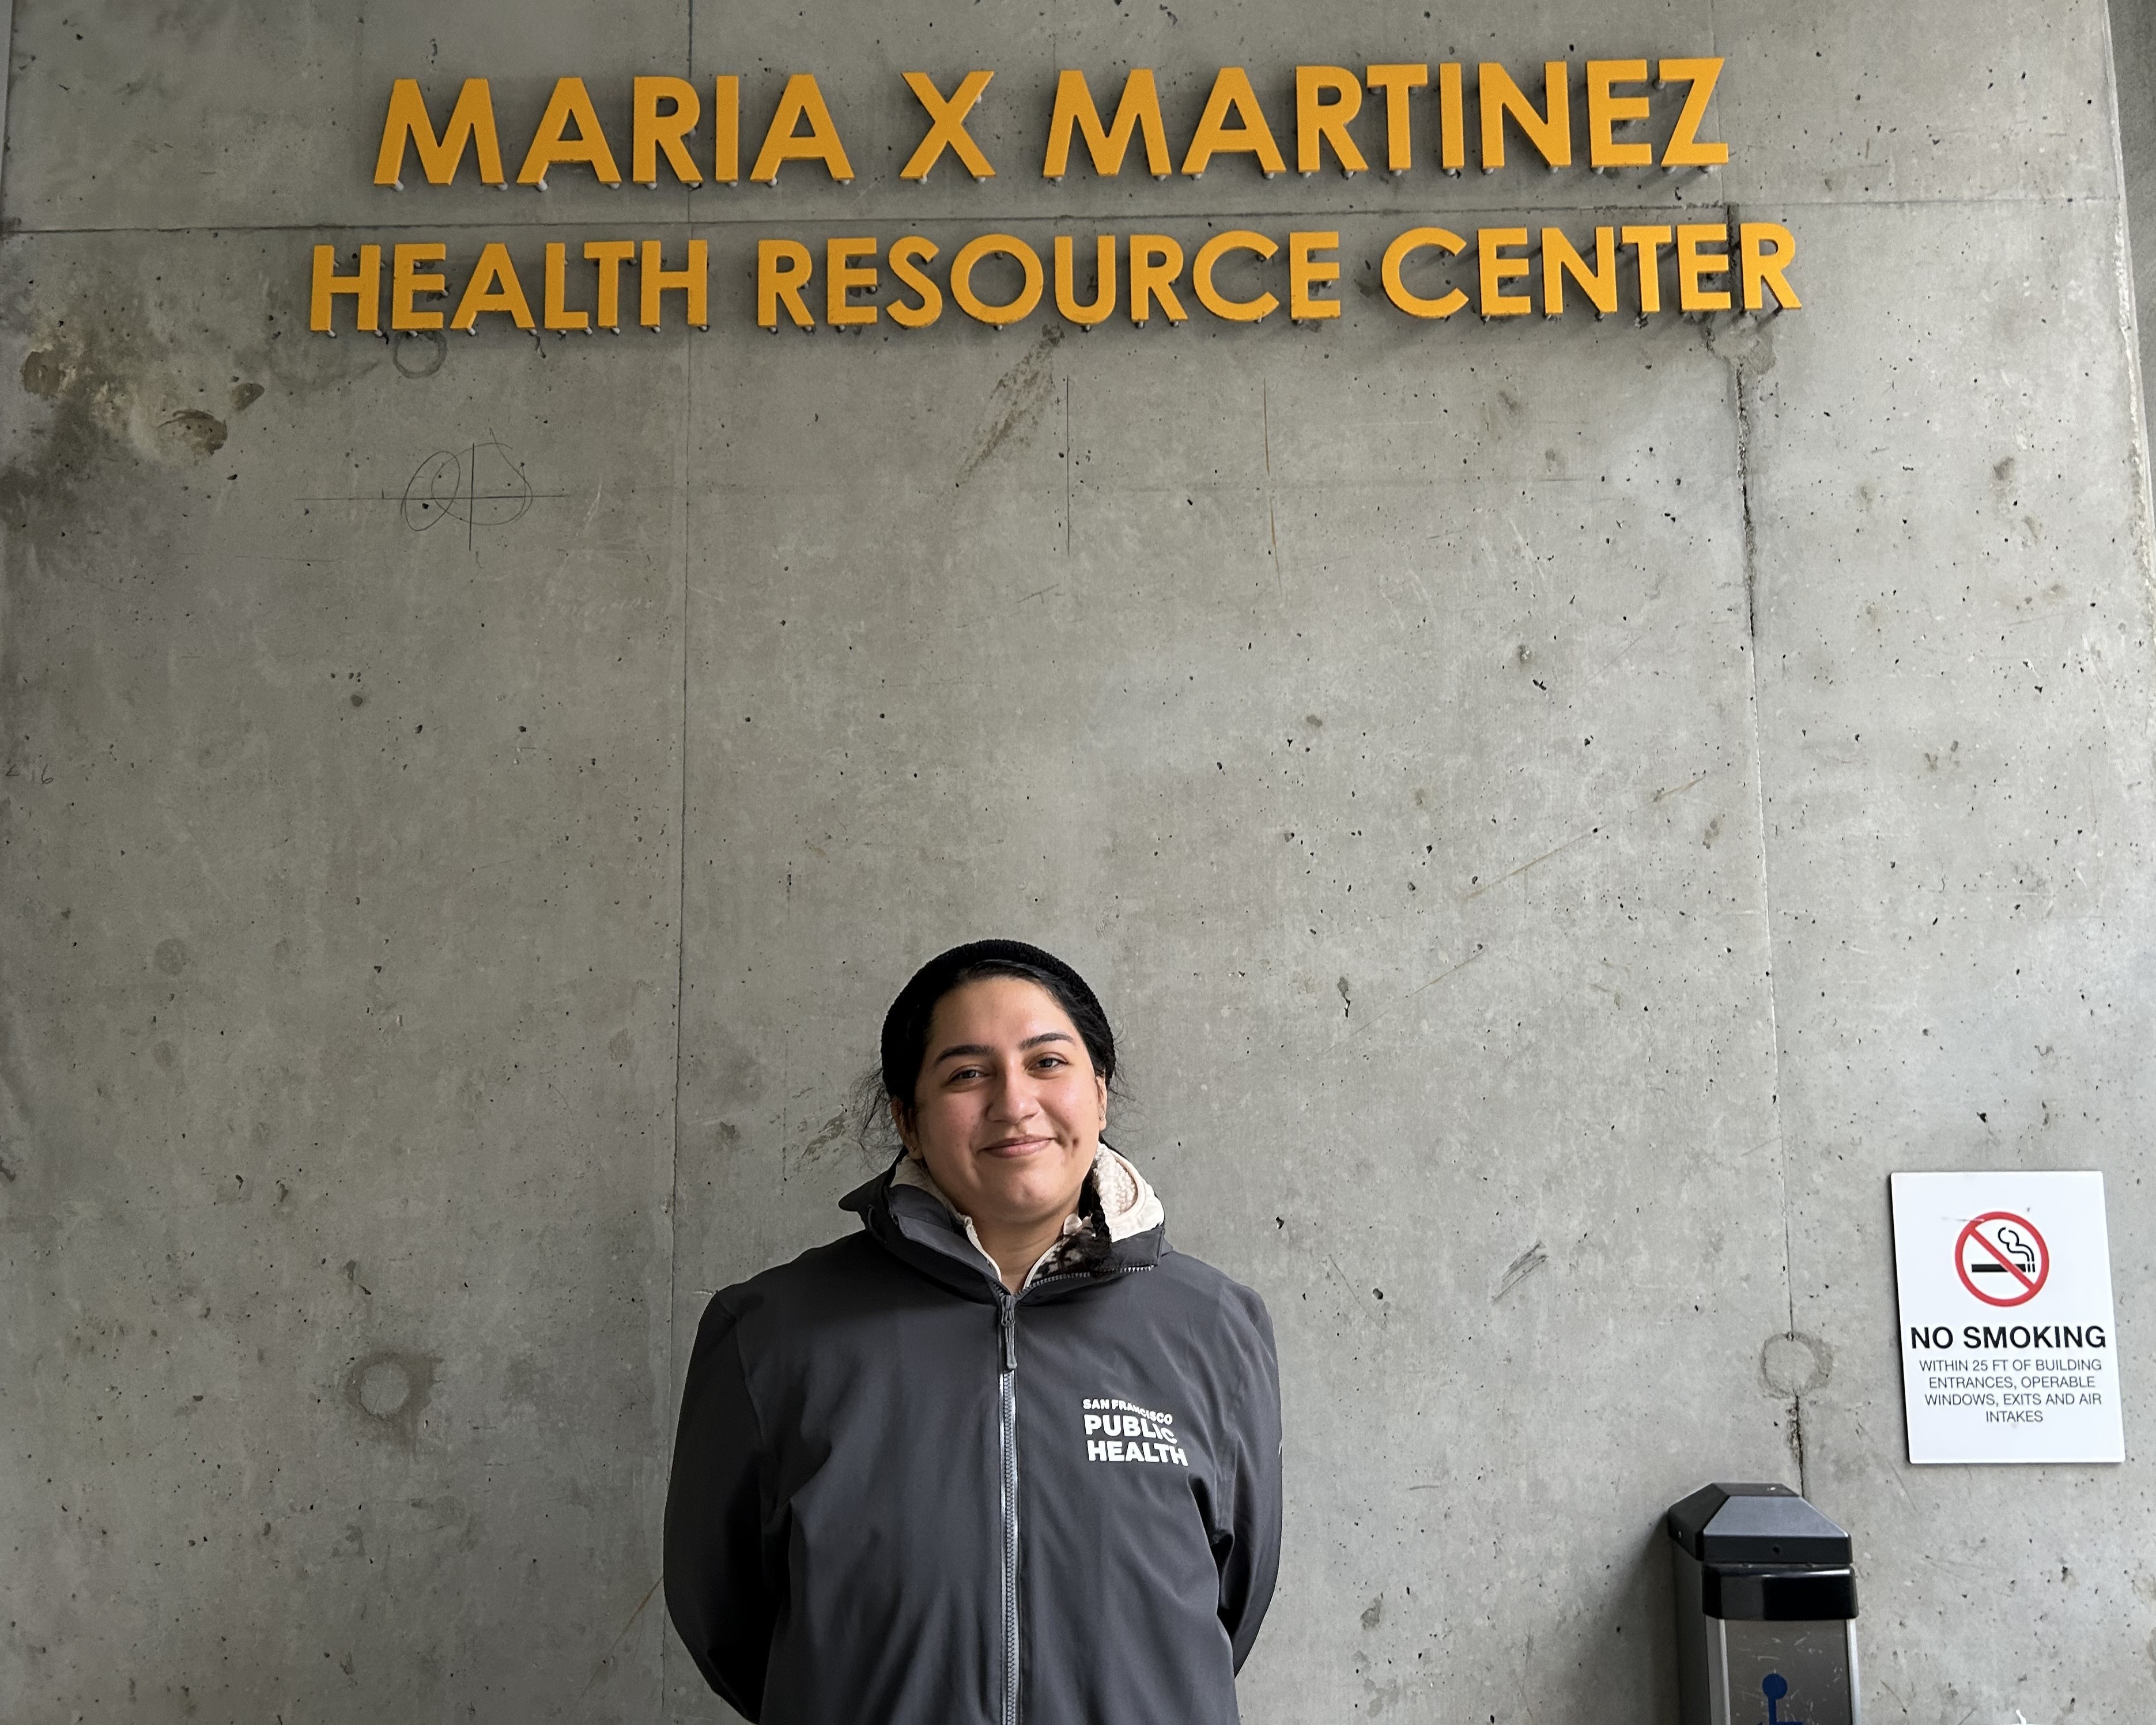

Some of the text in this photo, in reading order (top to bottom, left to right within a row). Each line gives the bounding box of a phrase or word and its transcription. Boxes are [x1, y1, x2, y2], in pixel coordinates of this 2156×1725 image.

[373, 57, 1728, 185] MARIA X MARTINEZ
[309, 222, 1800, 331] HEALTH RESOURCE CENTER
[1910, 1325, 2107, 1350] NO SMOKING
[1919, 1358, 2102, 1372] WITHIN 25 FT OF BUILDING
[1929, 1376, 2096, 1390] ENTRANCES, OPERABLE
[1083, 1398, 1173, 1425] SAN FRANCISCO
[1924, 1392, 2102, 1408] WINDOWS, EXITS AND AIR
[1083, 1414, 1178, 1444] PUBLIC
[1985, 1410, 2044, 1423] INTAKES
[1087, 1440, 1188, 1467] HEALTH
